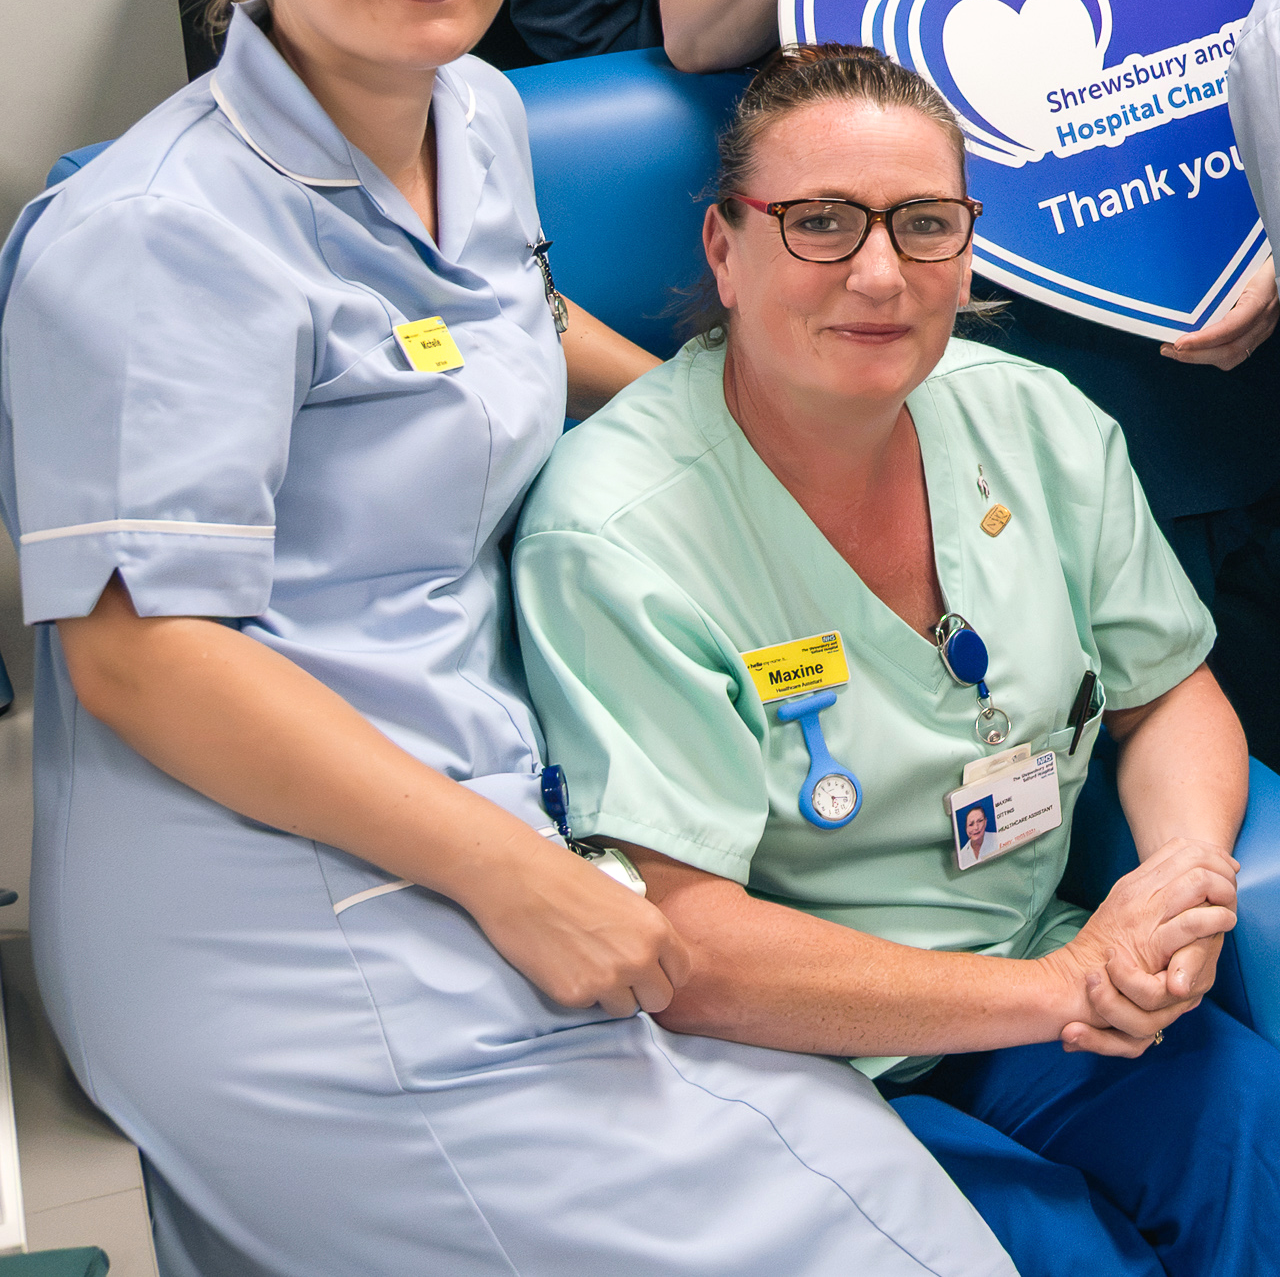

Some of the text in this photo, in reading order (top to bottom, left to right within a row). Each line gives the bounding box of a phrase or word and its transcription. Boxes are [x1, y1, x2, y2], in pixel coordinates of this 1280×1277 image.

[1046, 33, 1236, 113] Shrewsbury and
[1056, 94, 1164, 148] Hospital
[1038, 164, 1176, 235] Thank
[769, 664, 824, 685] Maxine
[776, 679, 822, 693] Healthcare Assistant
[1037, 753, 1053, 766] NHS
[995, 796, 1012, 807] MAXINE
[998, 805, 1053, 833] HEALTHCARE ASSISTANT
